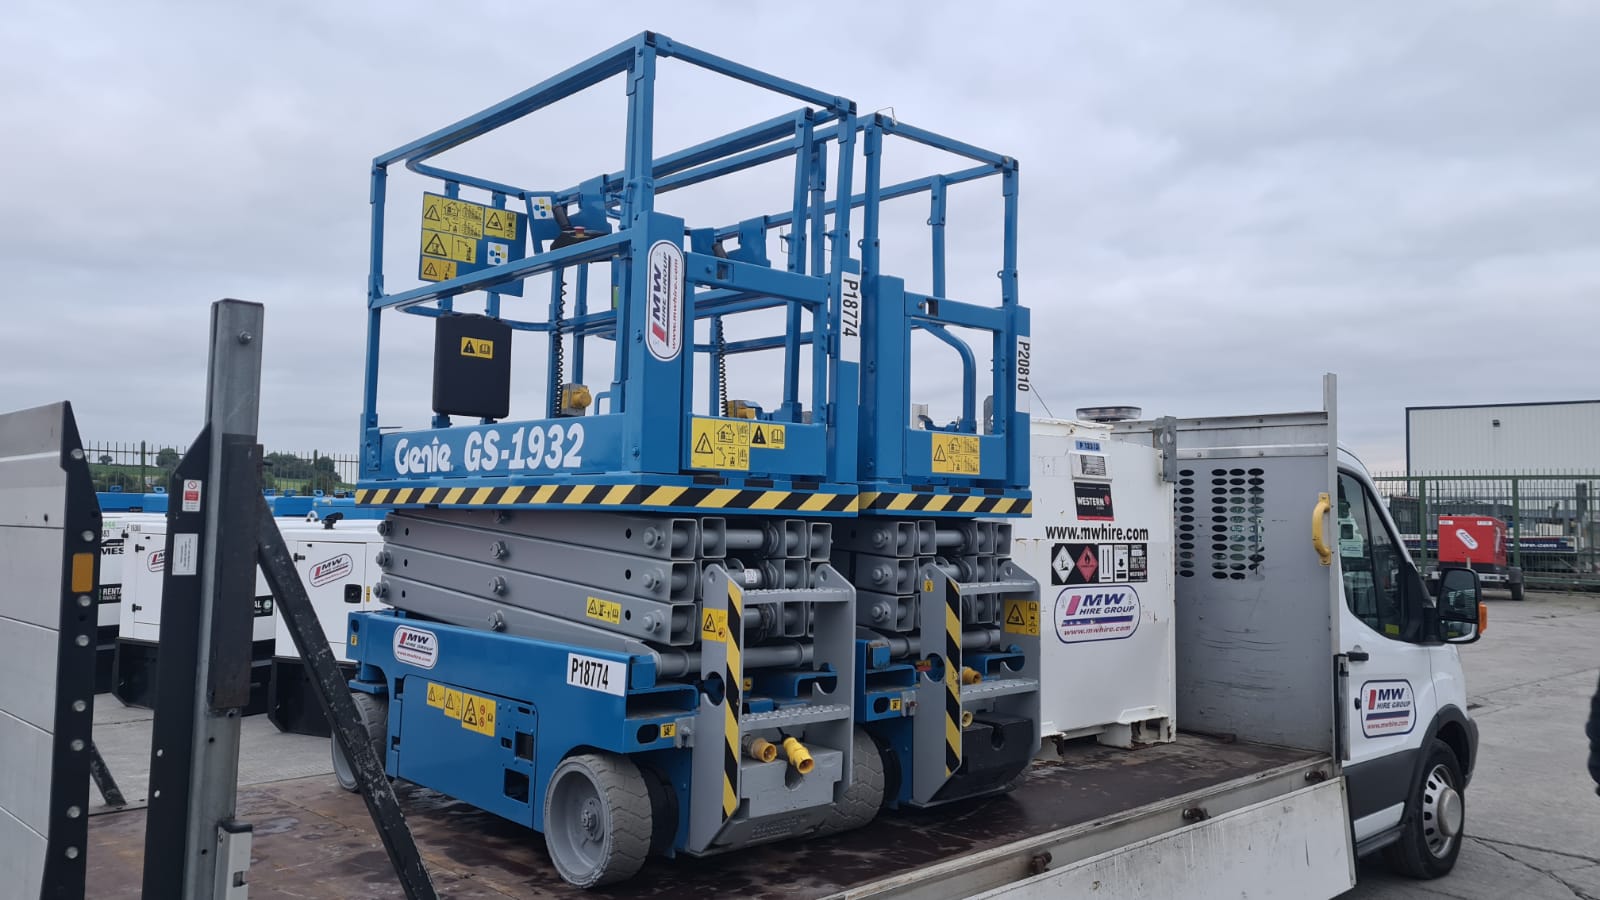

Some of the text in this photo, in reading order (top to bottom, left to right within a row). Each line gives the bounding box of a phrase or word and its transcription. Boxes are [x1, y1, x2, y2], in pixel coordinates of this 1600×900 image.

[653, 263, 662, 321] MW
[842, 279, 858, 337] P18774
[1017, 340, 1031, 392] P20810
[394, 422, 585, 475] Genie GS-1932
[1076, 496, 1105, 506] WESTERN
[1045, 523, 1149, 541] www.mwhire.com
[321, 558, 343, 571] MW
[1082, 593, 1126, 607] MW
[1079, 605, 1135, 615] HIRE GROUP
[1064, 625, 1132, 636] www.mwhire.com
[407, 633, 430, 645] MW
[571, 657, 609, 690] P18774
[1378, 687, 1405, 701] MW
[1377, 700, 1411, 710] HIRE GROUP
